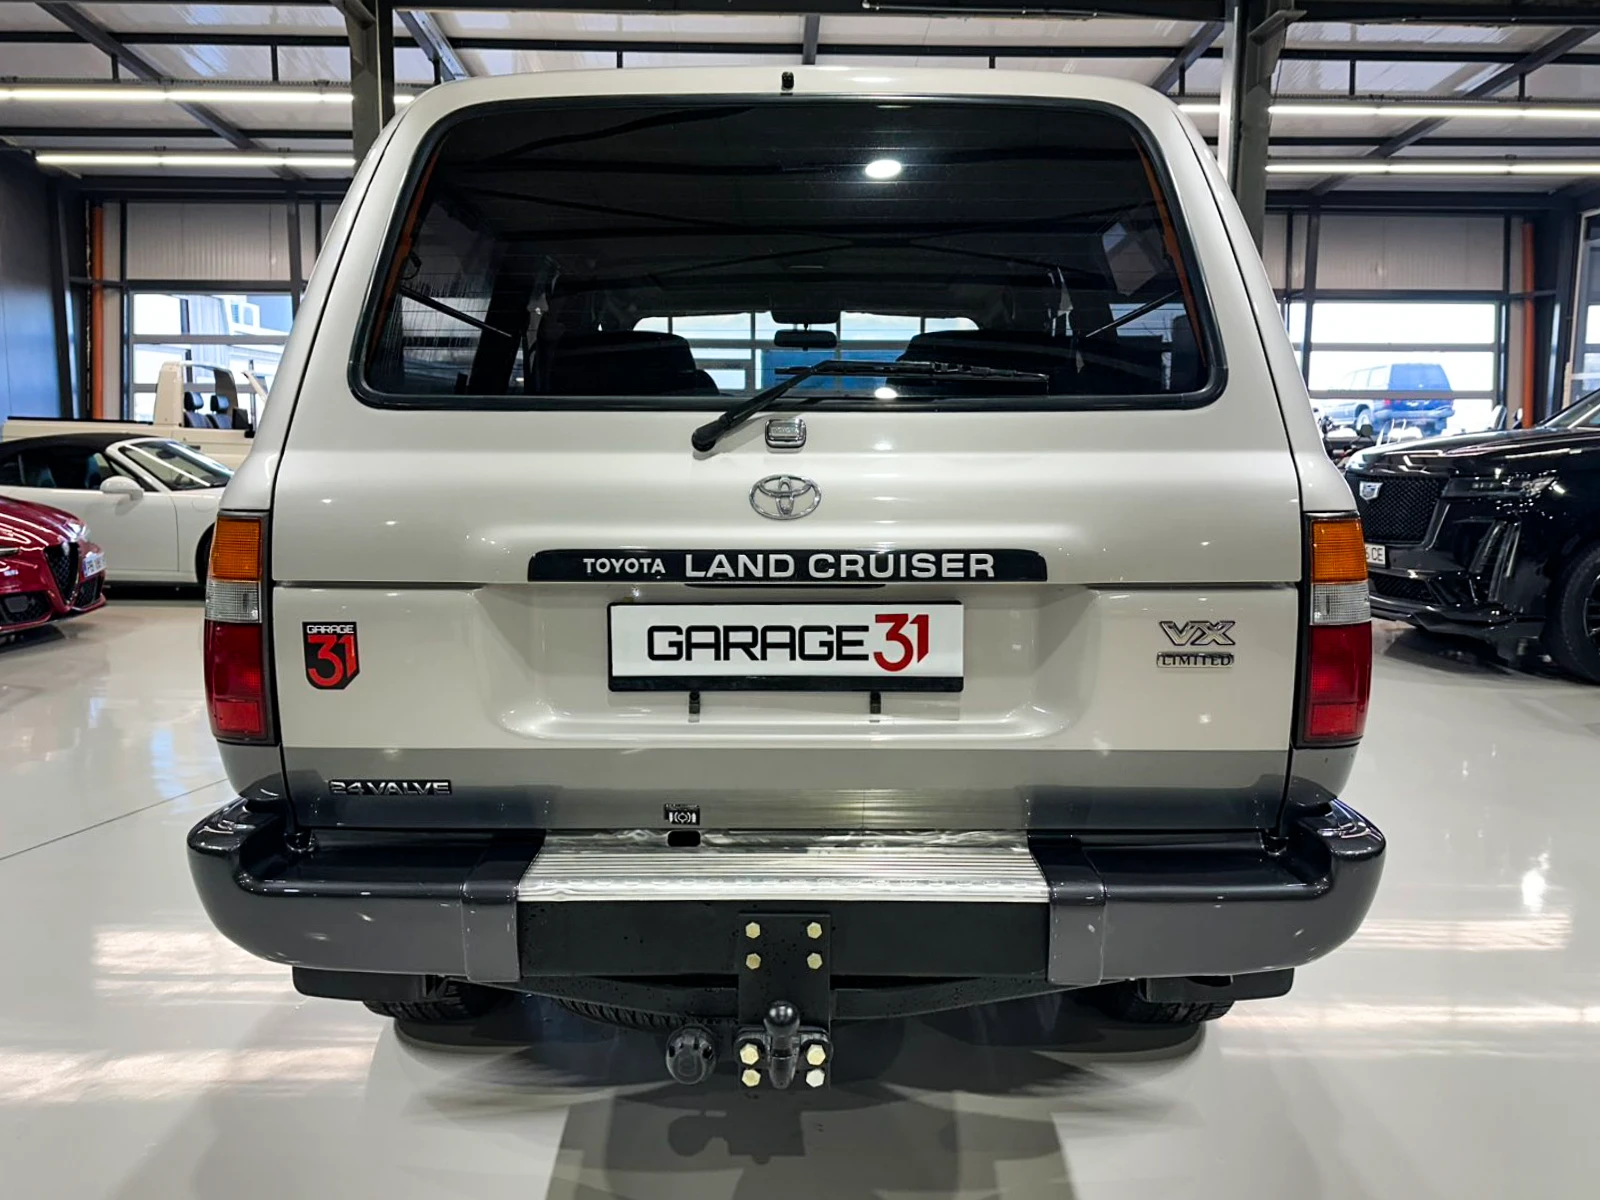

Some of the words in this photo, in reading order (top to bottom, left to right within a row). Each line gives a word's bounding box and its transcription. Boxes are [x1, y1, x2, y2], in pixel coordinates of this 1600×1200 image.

[1372, 547, 1384, 561] CE
[583, 558, 666, 574] TOYOTA
[685, 554, 795, 578] LAND
[808, 553, 995, 578] CRUISER
[307, 624, 355, 634] GARAGE
[1159, 621, 1236, 646] VX
[308, 635, 357, 687] 31
[1161, 655, 1232, 666] LIMITED
[330, 781, 364, 795] 24
[366, 782, 450, 795] VALVE
